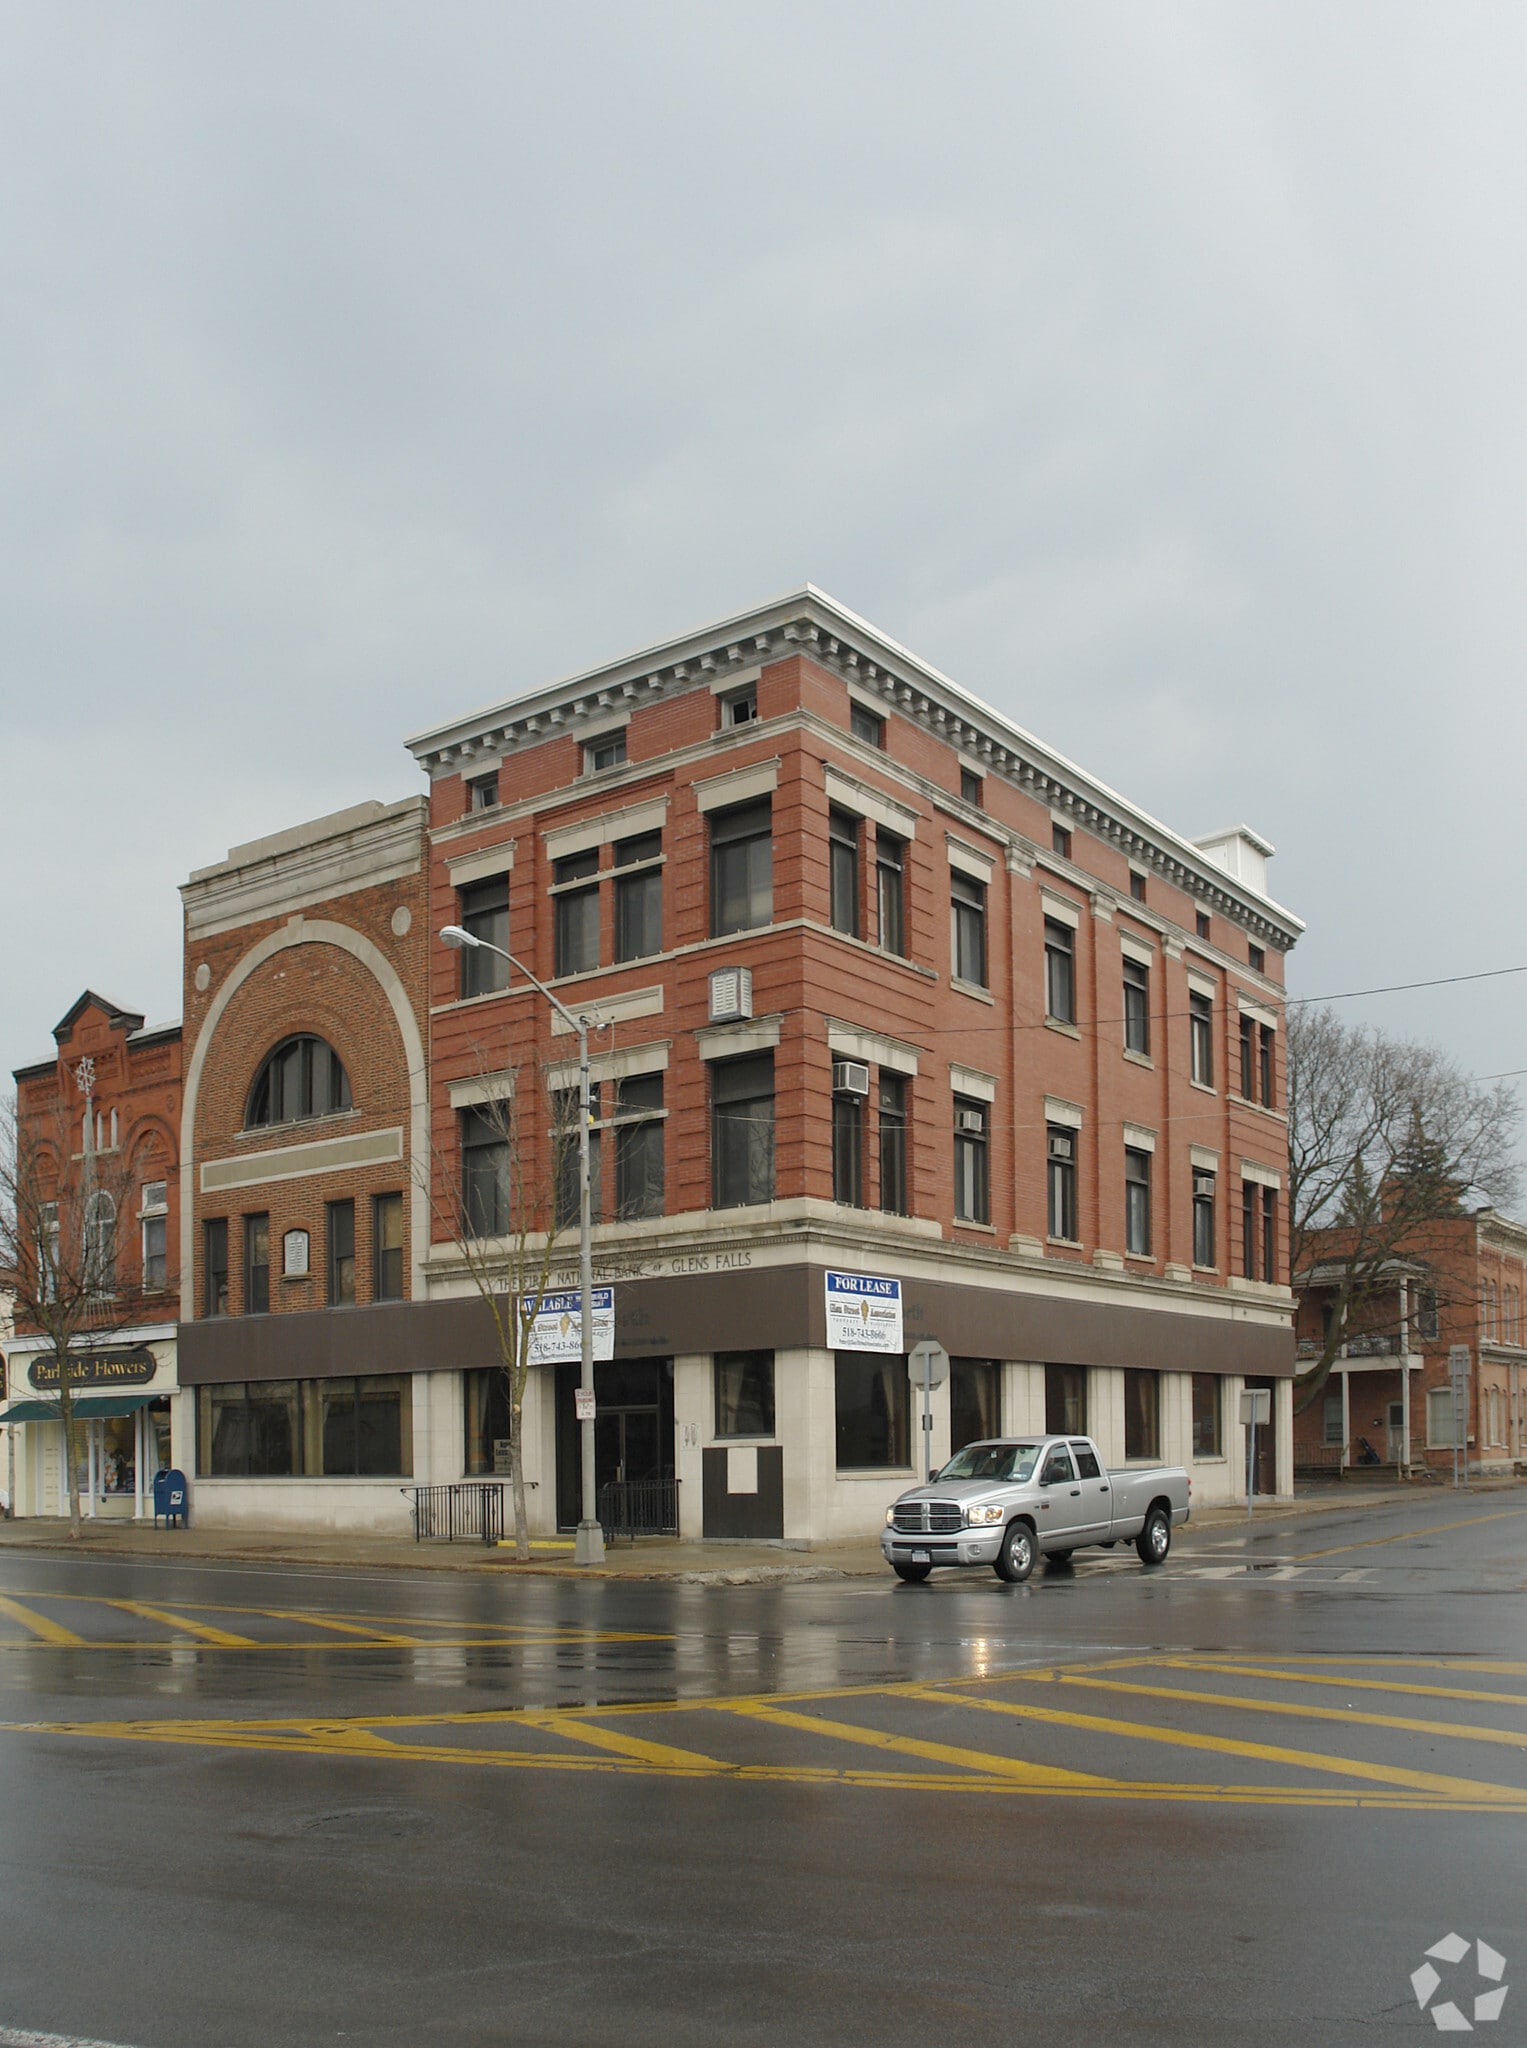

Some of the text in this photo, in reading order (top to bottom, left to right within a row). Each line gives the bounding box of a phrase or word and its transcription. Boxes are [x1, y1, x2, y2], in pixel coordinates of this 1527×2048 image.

[498, 1276, 518, 1291] THE
[523, 1274, 550, 1289] FIRT
[558, 1267, 609, 1286] NATINAL
[672, 1256, 709, 1273] GLENS
[716, 1252, 751, 1269] FALLS
[835, 1276, 892, 1294] FOR LEASE
[522, 1296, 572, 1312] AVLABLE
[534, 1340, 583, 1352] 518-743-86
[36, 1359, 147, 1379] Paride Flowers
